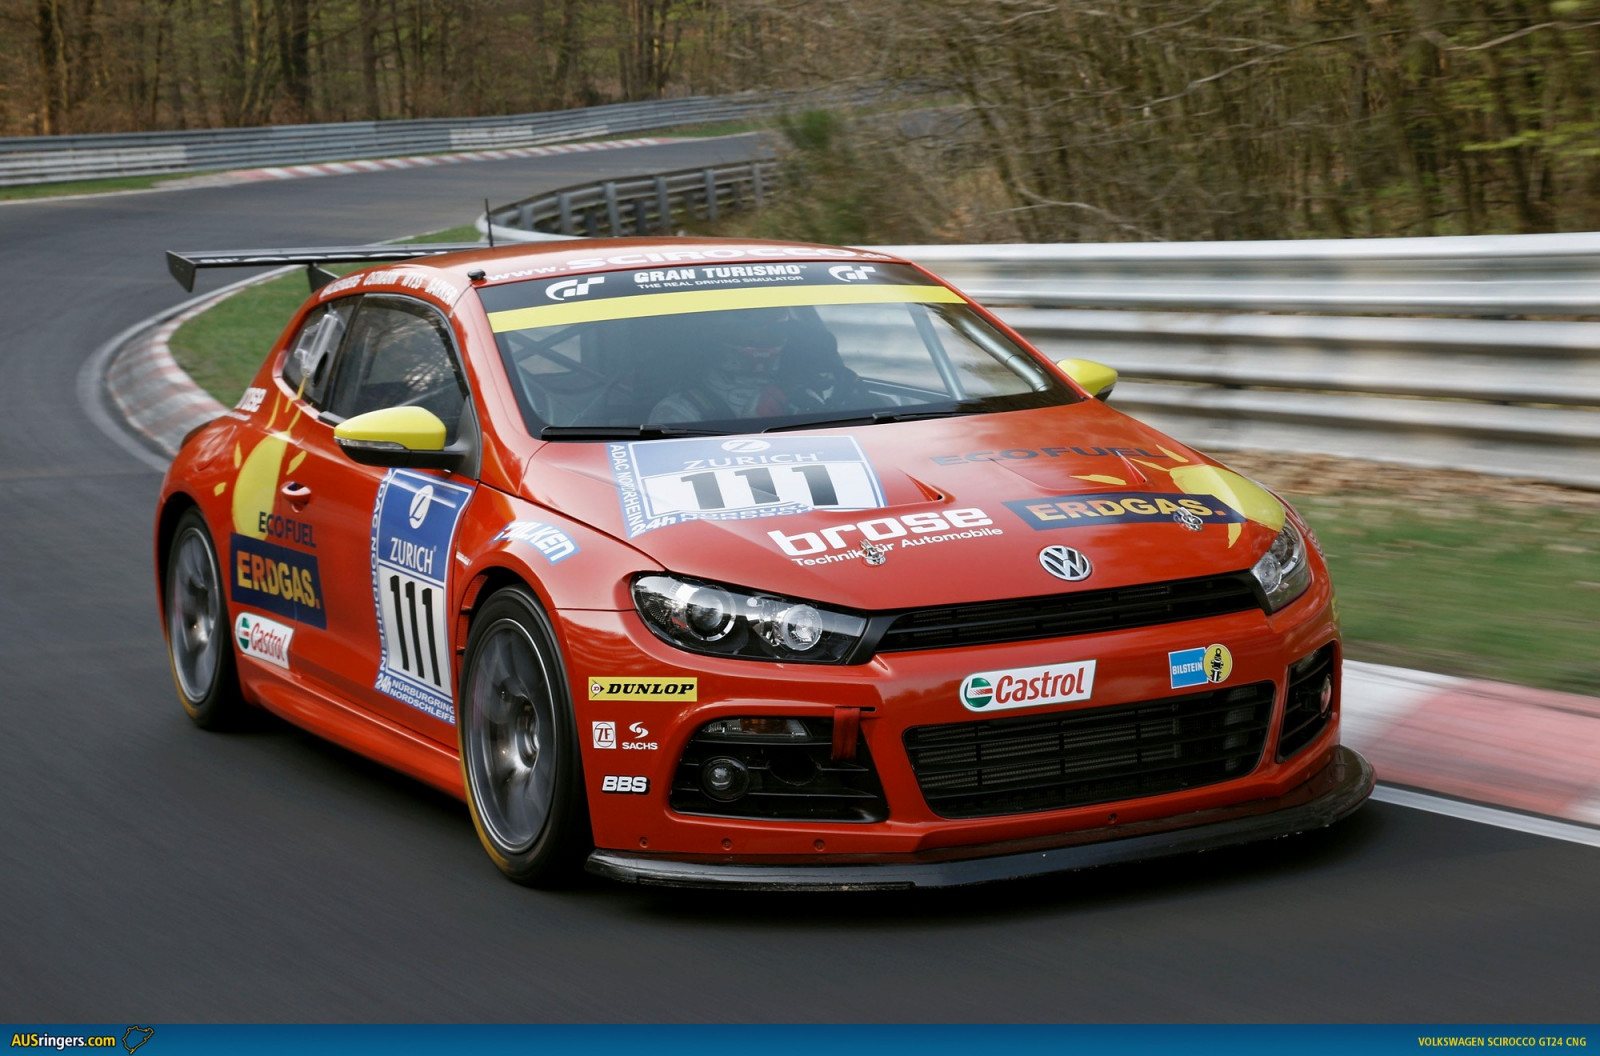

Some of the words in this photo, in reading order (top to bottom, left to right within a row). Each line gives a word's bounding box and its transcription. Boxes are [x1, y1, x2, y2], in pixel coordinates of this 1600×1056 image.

[634, 269, 696, 283] GRAN
[743, 275, 804, 283] SIMULATOR
[610, 444, 629, 471] ADAC
[684, 453, 819, 471] ZURICH
[930, 447, 1172, 466] ECOFUEL
[681, 465, 839, 510] 111
[1026, 497, 1227, 521] ERDGAS.
[258, 511, 317, 548] ECOFUEL
[767, 508, 994, 556] brose
[390, 537, 434, 575] ZURICH
[792, 548, 866, 567] Technik
[901, 527, 1004, 548] Automobile
[237, 550, 321, 609] ERDGAS.
[250, 622, 287, 662] Castrol
[389, 575, 443, 688] 111
[1172, 662, 1203, 675] BILSTEIN
[374, 672, 392, 694] 24h
[606, 683, 695, 694] DUNLOP
[995, 667, 1085, 704] Castrol
[389, 687, 456, 724] NORDSCHLEIFE
[621, 742, 659, 750] SACHS
[602, 775, 648, 793] BBS
